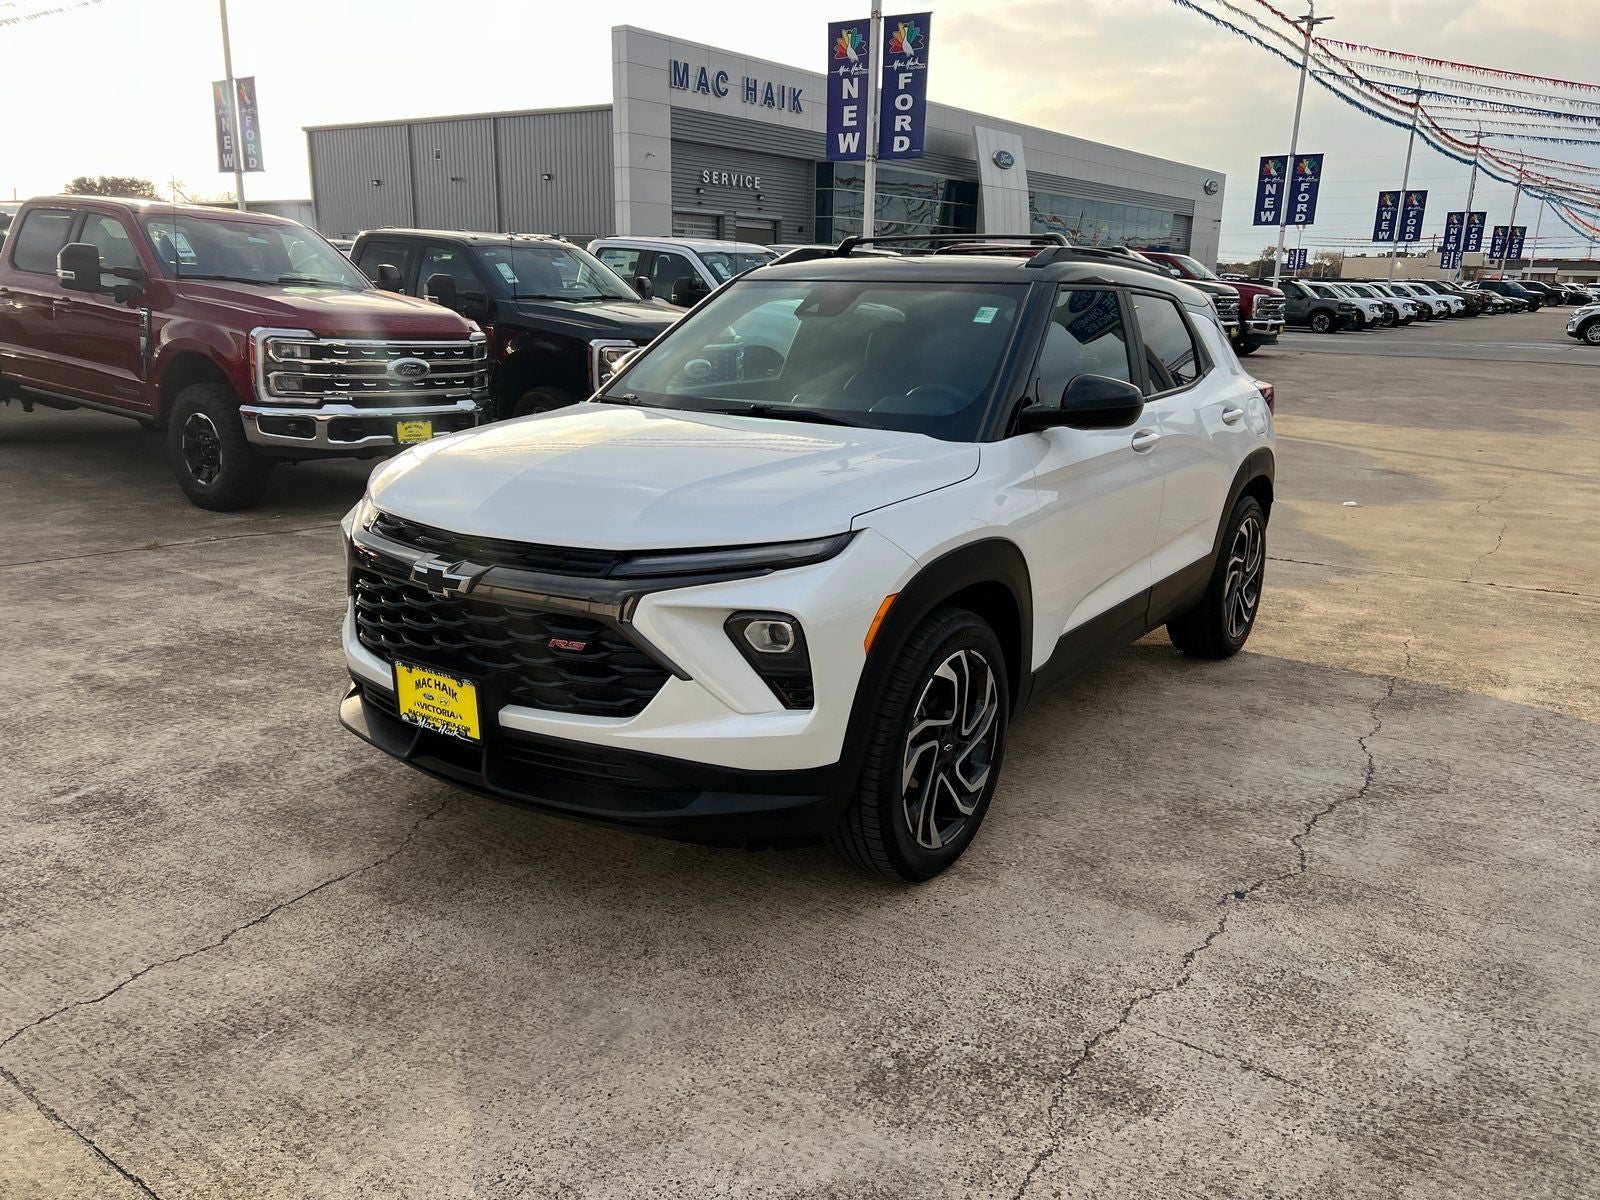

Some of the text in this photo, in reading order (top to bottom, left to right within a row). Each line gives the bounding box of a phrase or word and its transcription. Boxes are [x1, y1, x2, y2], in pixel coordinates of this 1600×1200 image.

[671, 60, 803, 113] MAC HAIK
[838, 77, 860, 154] NEW
[892, 72, 914, 153] FORD
[221, 117, 233, 168] NEW
[245, 115, 258, 169] FORD
[702, 169, 761, 189] SERVICE
[1260, 183, 1278, 222] NEW
[1295, 182, 1310, 222] FORD
[1378, 211, 1391, 240] NEW
[1405, 210, 1417, 240] FORD
[1447, 227, 1457, 250] NEW
[1468, 227, 1478, 251] FORD
[1493, 238, 1502, 258] NEW
[1511, 238, 1519, 258] FORD
[402, 364, 420, 375] Ford
[549, 639, 586, 650] RS
[415, 678, 432, 690] MAC
[434, 680, 458, 702] HAIK
[419, 702, 455, 718] VICTORIA
